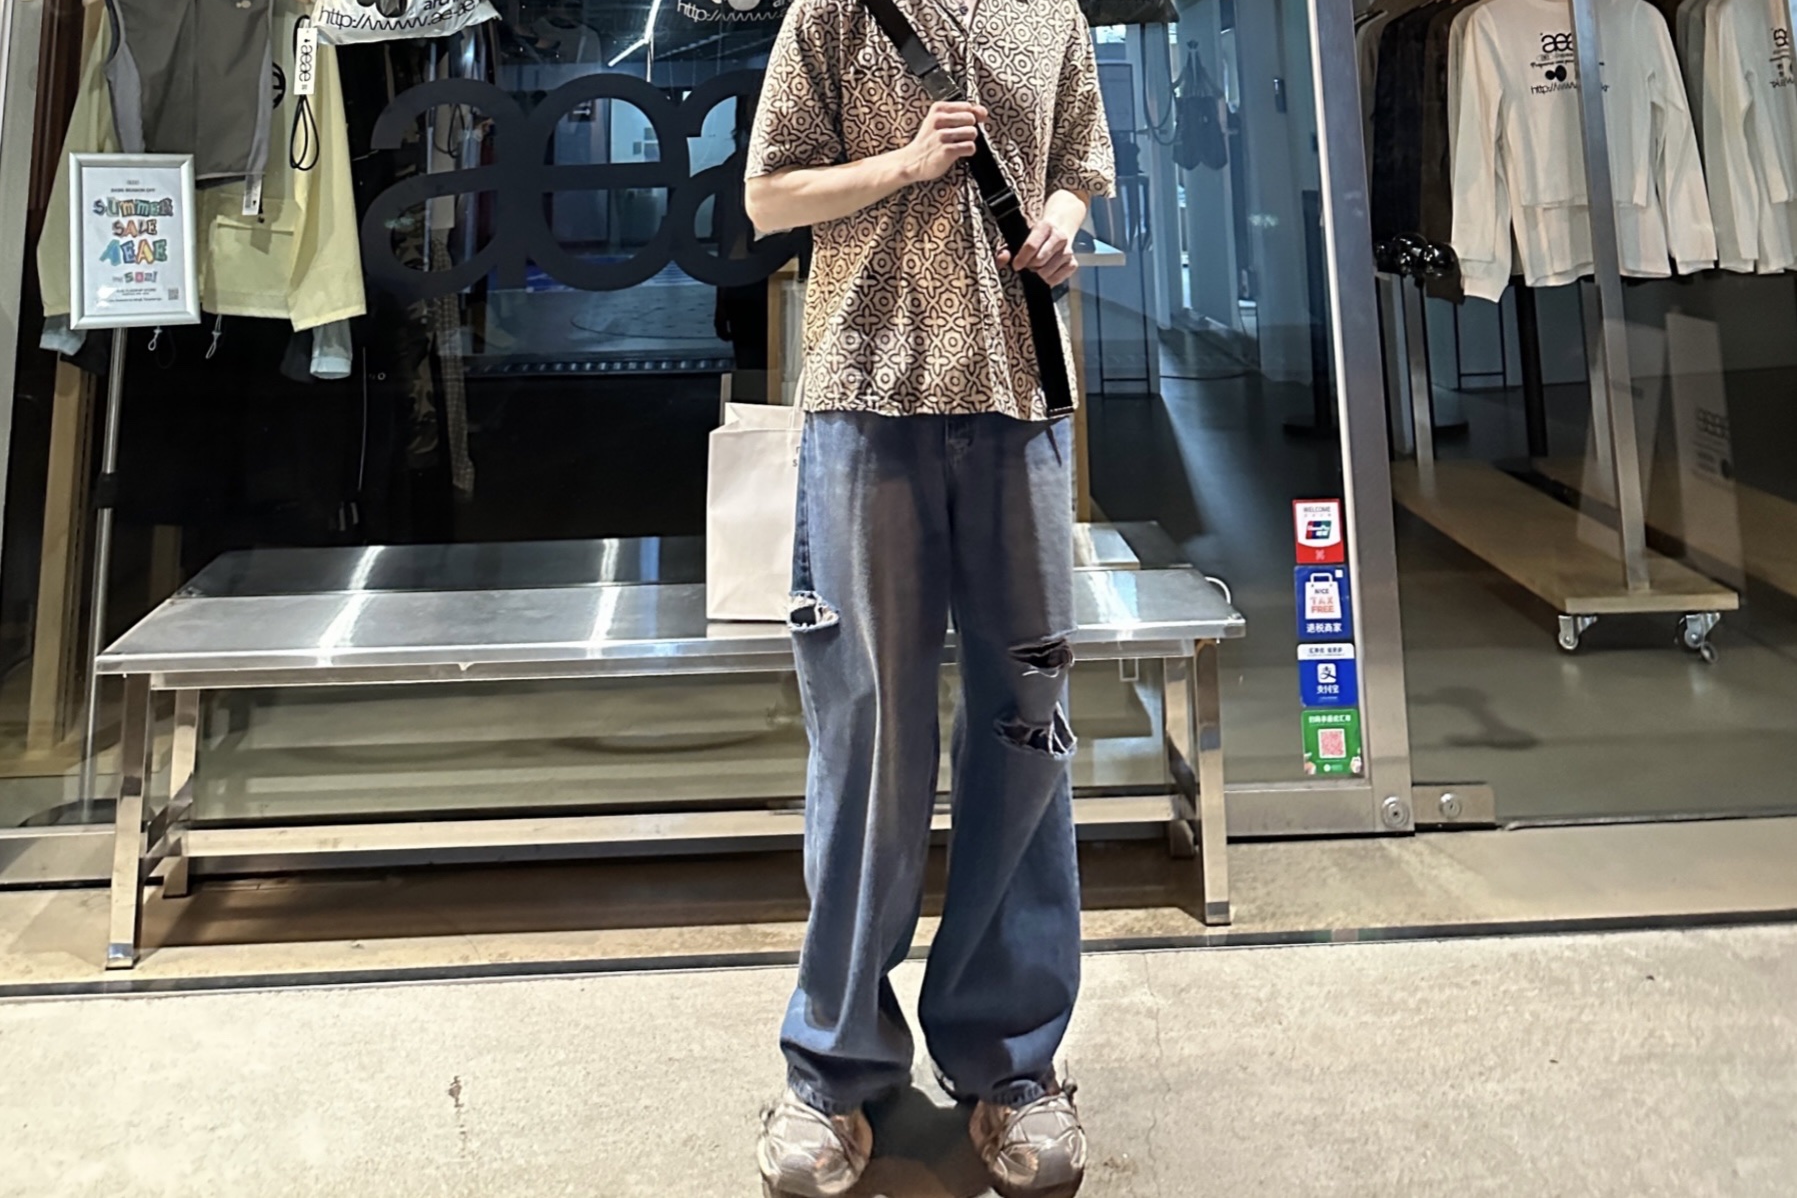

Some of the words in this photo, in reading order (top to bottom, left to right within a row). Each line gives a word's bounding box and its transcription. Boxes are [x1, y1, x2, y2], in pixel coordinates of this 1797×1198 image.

[112, 218, 158, 238] SALE
[99, 239, 168, 266] AEAE
[1310, 596, 1334, 604] TAX
[1311, 605, 1334, 613] FREE
